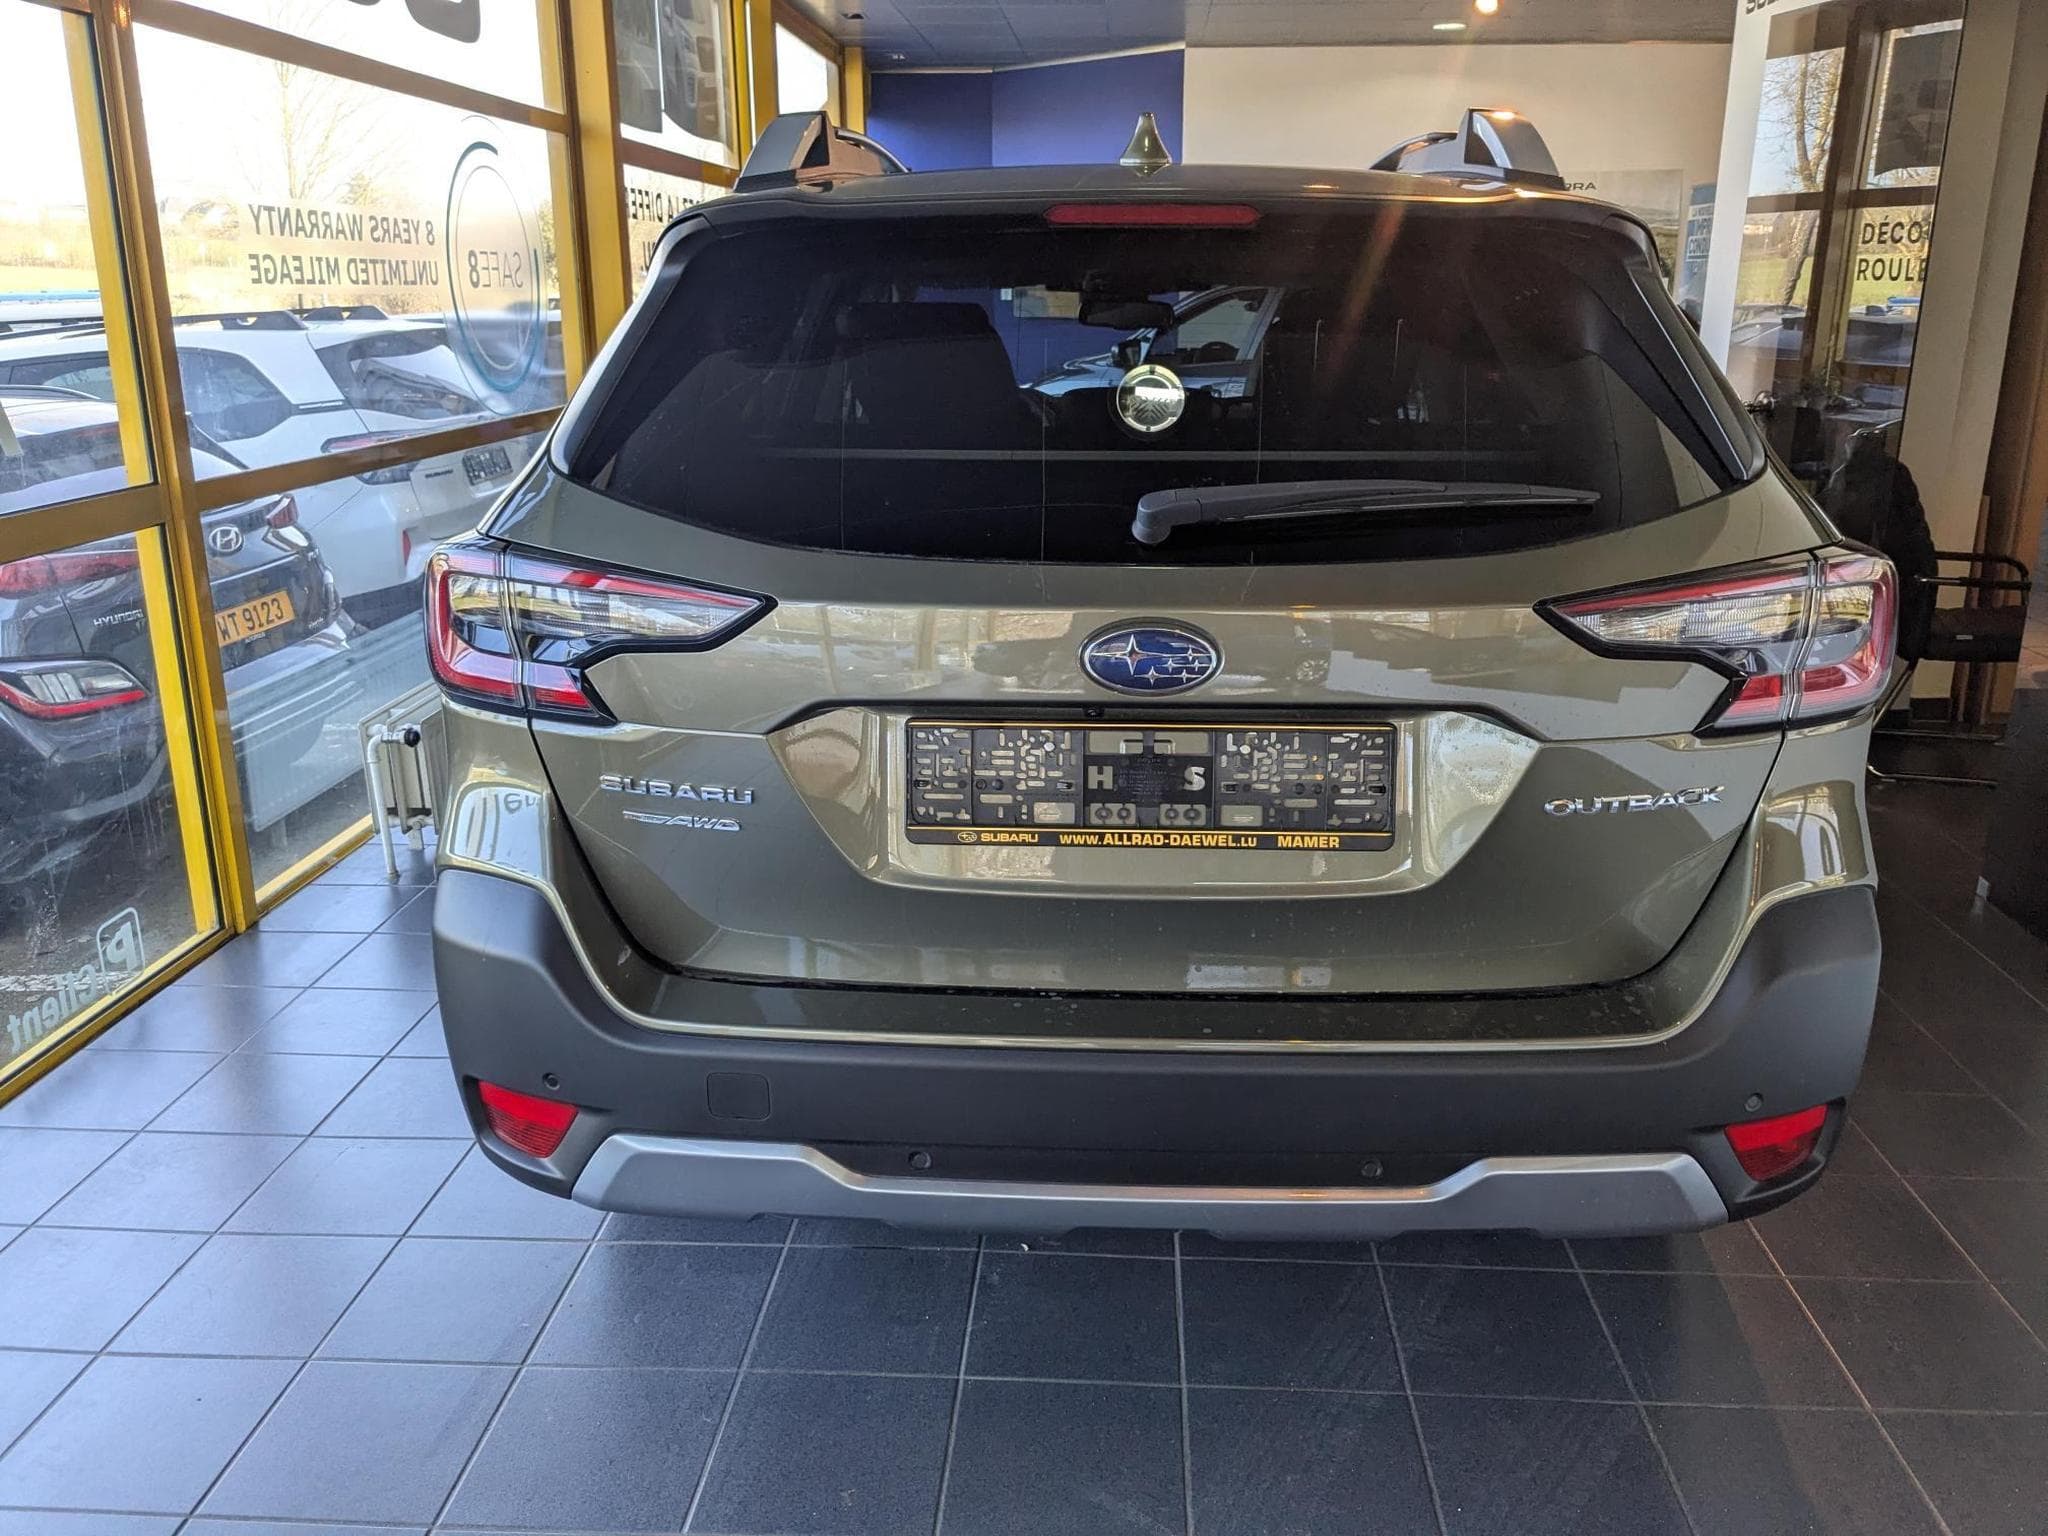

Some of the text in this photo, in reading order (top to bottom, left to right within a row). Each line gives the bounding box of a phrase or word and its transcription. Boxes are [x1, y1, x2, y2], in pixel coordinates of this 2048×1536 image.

[243, 598, 284, 631] 9123
[600, 774, 755, 806] SUBARU
[1543, 785, 1726, 816] OUTBACK
[980, 832, 1039, 843] SUBARU
[1277, 836, 1341, 849] MAMER
